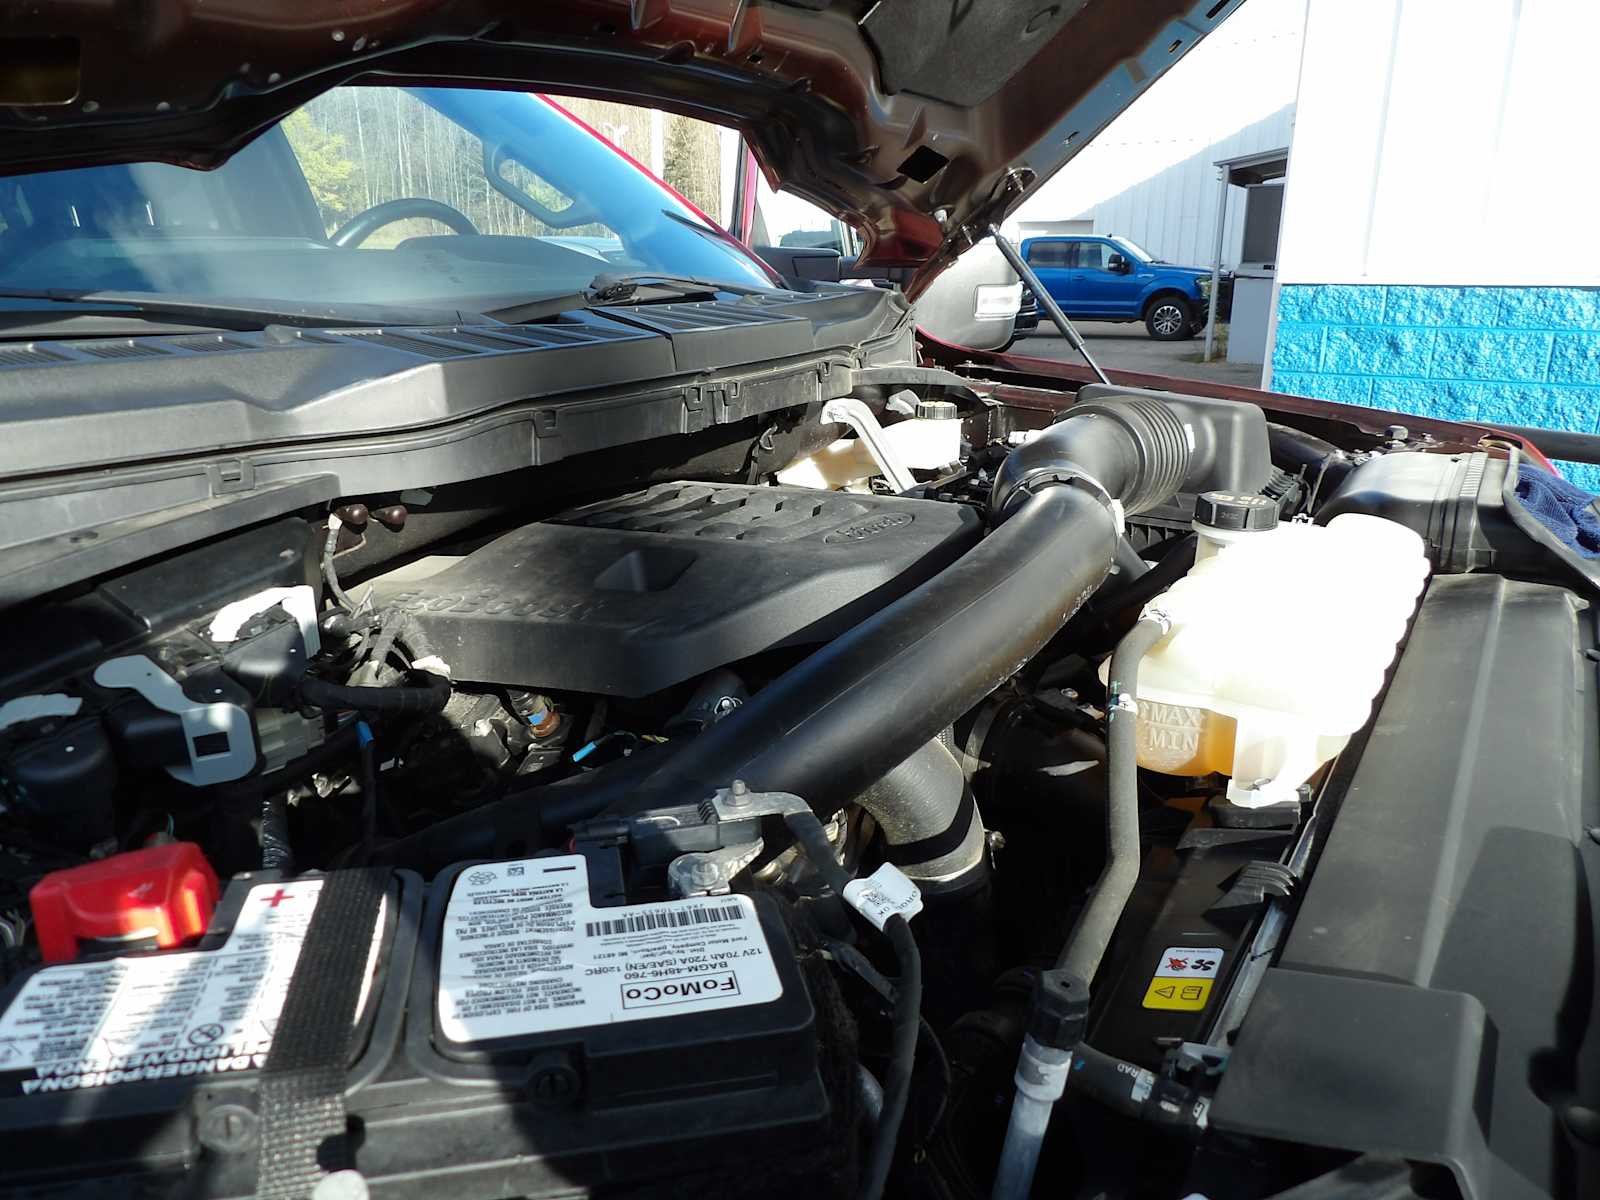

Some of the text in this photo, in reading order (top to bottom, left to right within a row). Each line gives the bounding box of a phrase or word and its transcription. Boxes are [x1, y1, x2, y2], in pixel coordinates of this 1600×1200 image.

[1151, 702, 1202, 728] MAX
[1149, 726, 1199, 752] MIN
[679, 955, 708, 964] 720A
[710, 951, 740, 960] 70Ah
[742, 948, 763, 957] 12V
[625, 976, 735, 1001] FoMoCo
[1117, 1062, 1140, 1079] RAD
